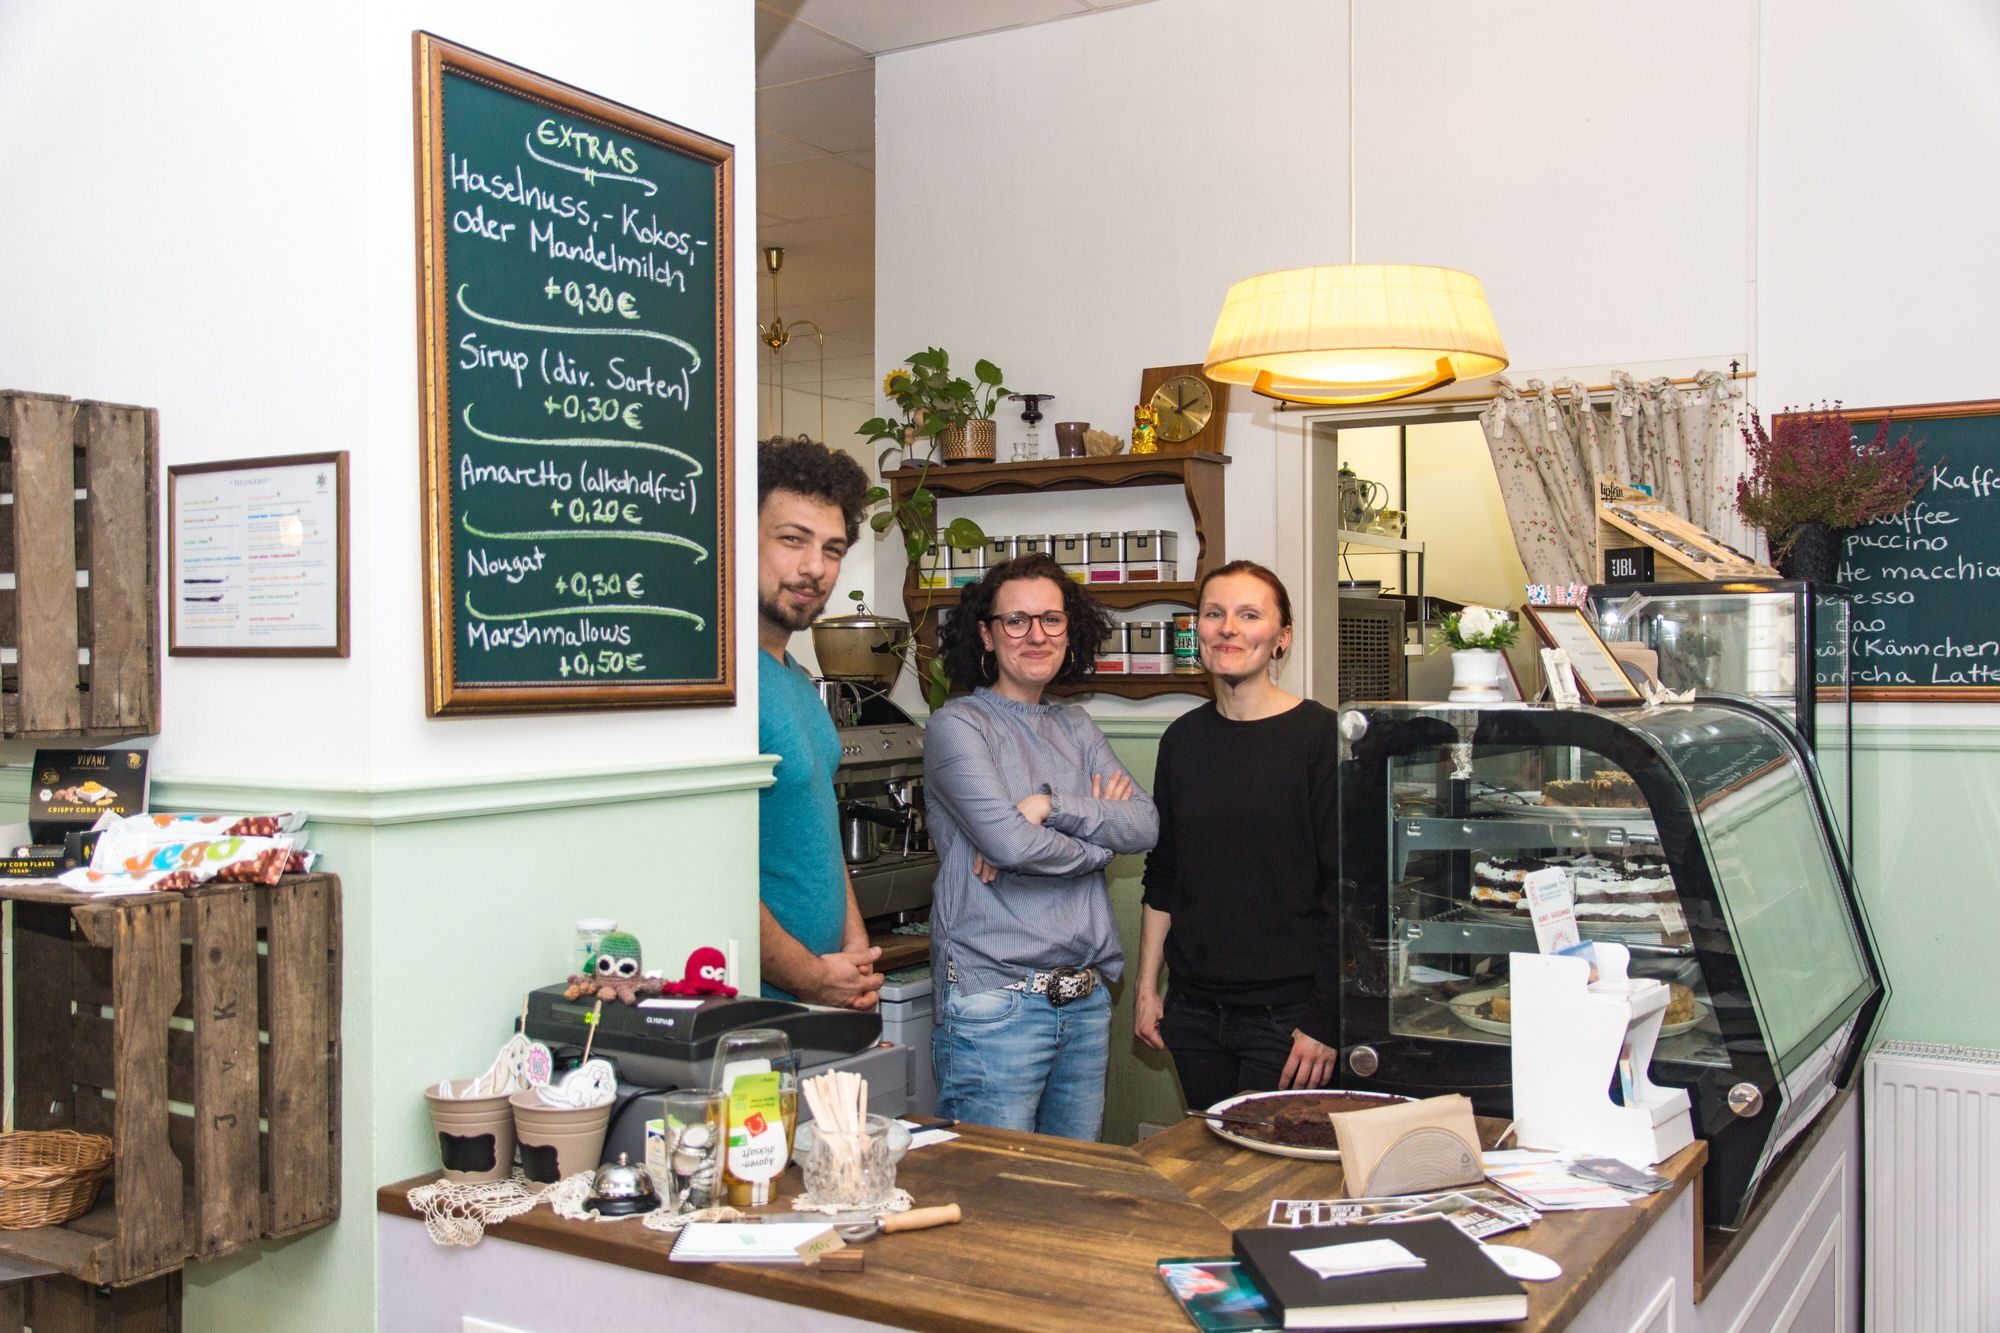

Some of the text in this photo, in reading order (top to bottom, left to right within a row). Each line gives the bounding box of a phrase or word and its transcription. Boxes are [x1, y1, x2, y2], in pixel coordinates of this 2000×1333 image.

[537, 120, 639, 174] EXTRAS
[454, 205, 685, 292] oder Mandelmilch
[460, 333, 689, 411] Sirup (div. Sorten)
[460, 453, 697, 515] Amaretto (alkoholfrei)
[1870, 501, 1961, 536] affee
[1845, 535, 1949, 557] puccino
[467, 545, 546, 583] Nougat
[1612, 558, 1637, 577] JBL
[467, 618, 631, 651] Marshmallows
[741, 1156, 775, 1168] Agaven-
[742, 1145, 776, 1159] dicksaft
